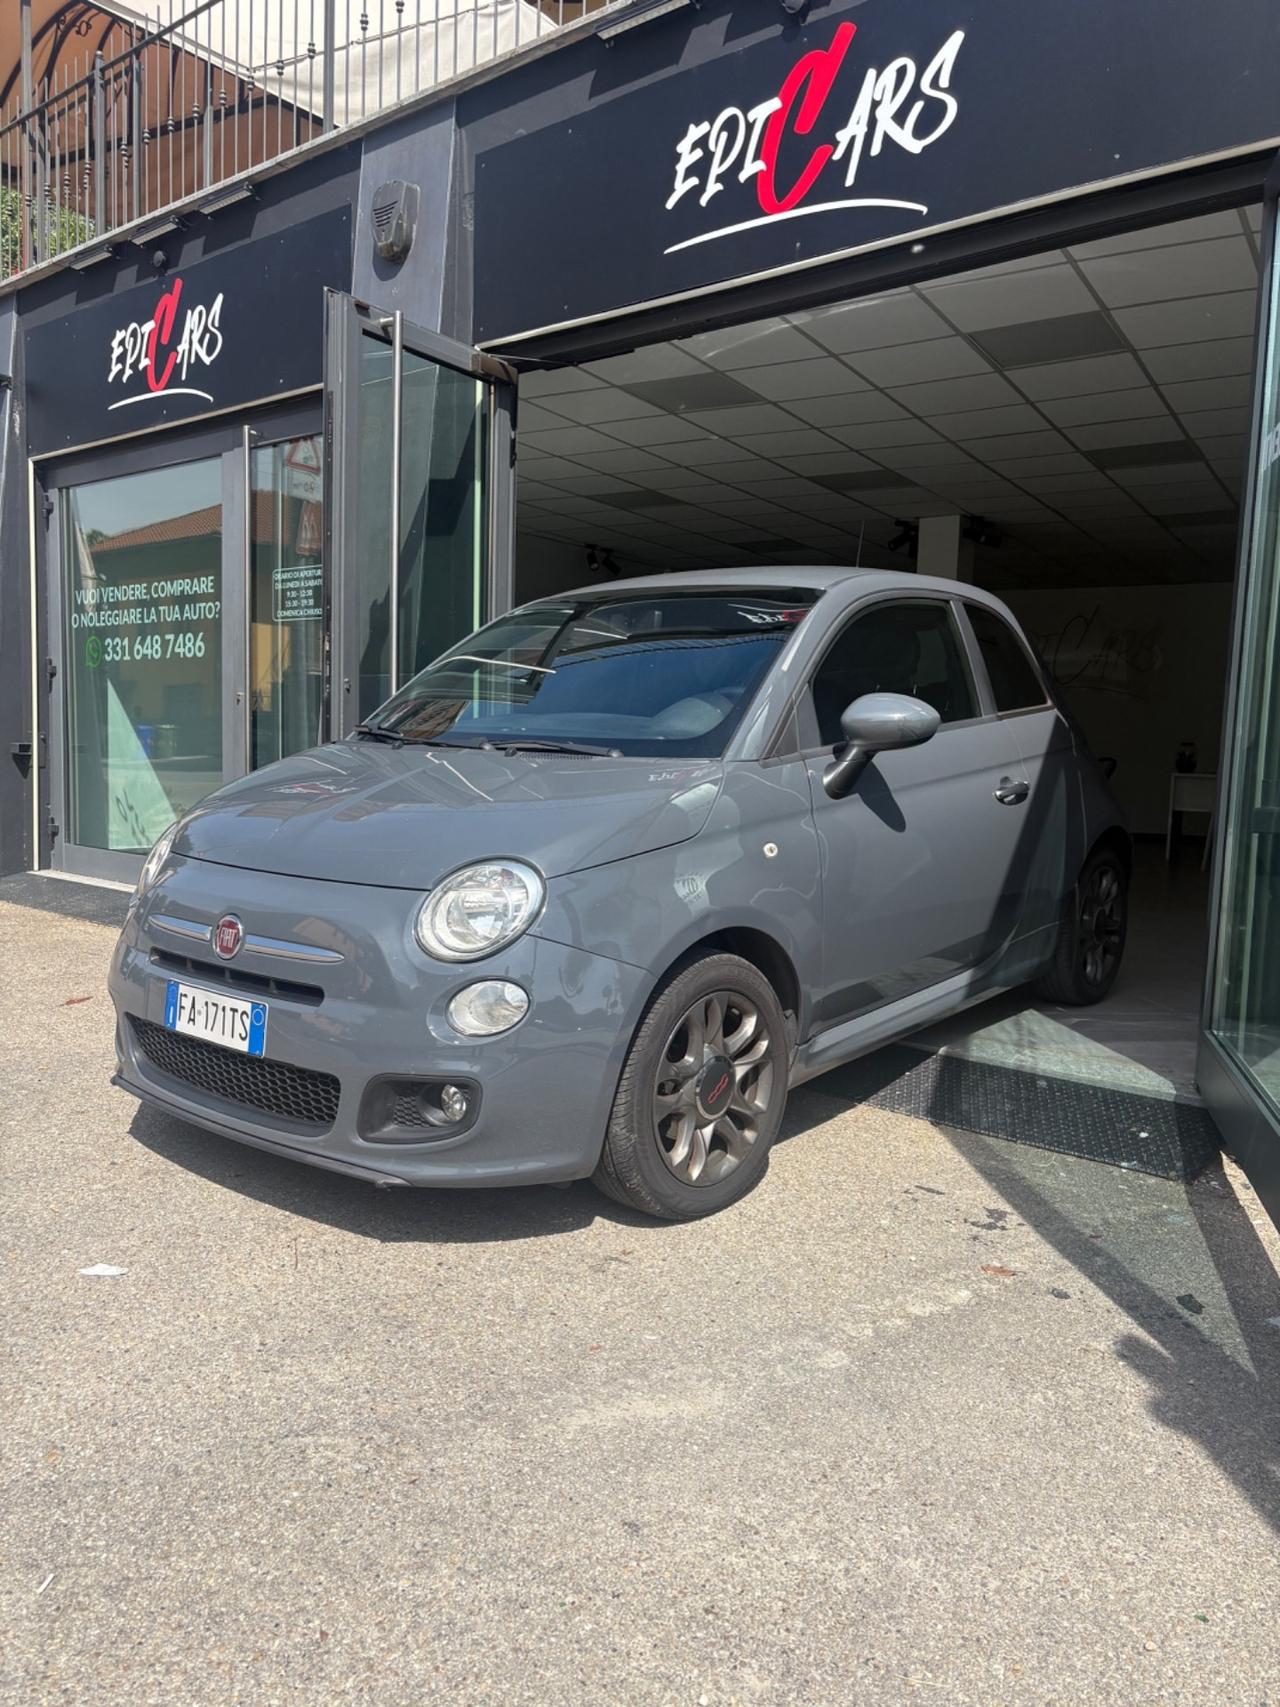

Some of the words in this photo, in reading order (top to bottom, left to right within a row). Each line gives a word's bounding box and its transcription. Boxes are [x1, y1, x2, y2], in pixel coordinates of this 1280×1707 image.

[664, 21, 966, 215] EPICARS
[107, 277, 224, 392] EPICARS
[300, 569, 321, 578] APERTUR
[75, 588, 100, 605] VUOI
[101, 583, 150, 602] VENDERE,
[151, 576, 215, 598] COMPRARE
[71, 613, 79, 628] O
[80, 608, 142, 627] NOLEGGIARE
[143, 607, 157, 623] LA
[158, 605, 181, 622] TUA
[182, 601, 221, 621] AUTO?
[104, 637, 131, 661] 331
[133, 635, 162, 660] 648
[165, 632, 205, 659] 7486
[220, 927, 238, 948] FIAT
